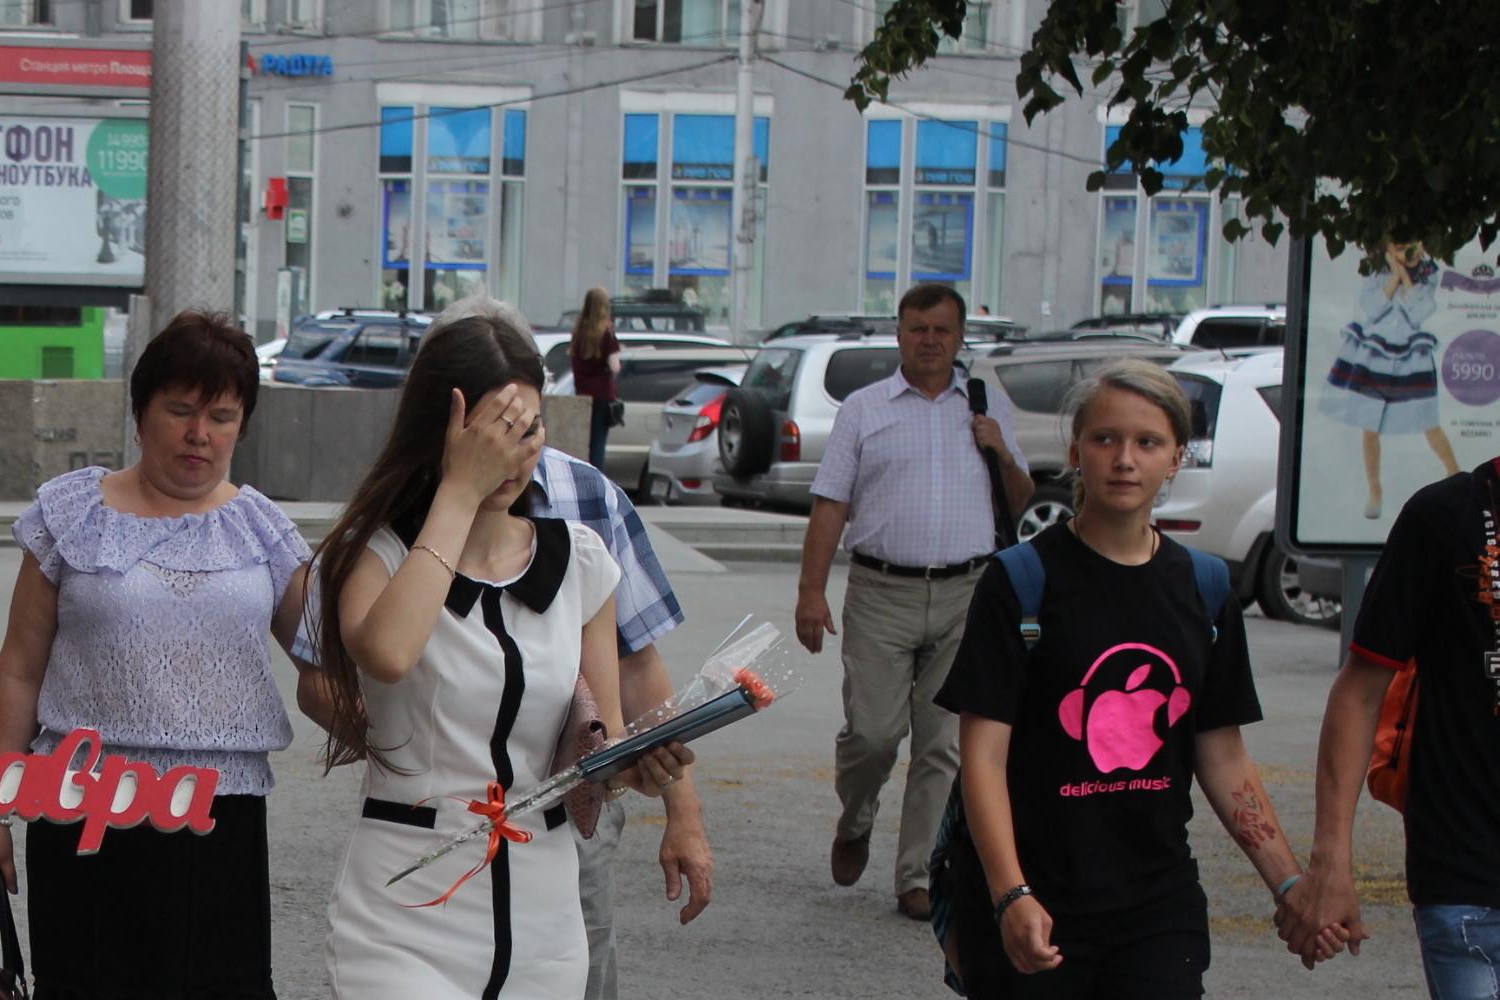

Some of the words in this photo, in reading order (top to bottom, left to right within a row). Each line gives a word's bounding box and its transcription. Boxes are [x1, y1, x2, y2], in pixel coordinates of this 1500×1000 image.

[19, 57, 70, 74] Станция
[71, 61, 108, 76] метро
[1451, 363, 1495, 381] 5990
[1059, 780, 1126, 797] delicious
[1129, 775, 1173, 791] music
